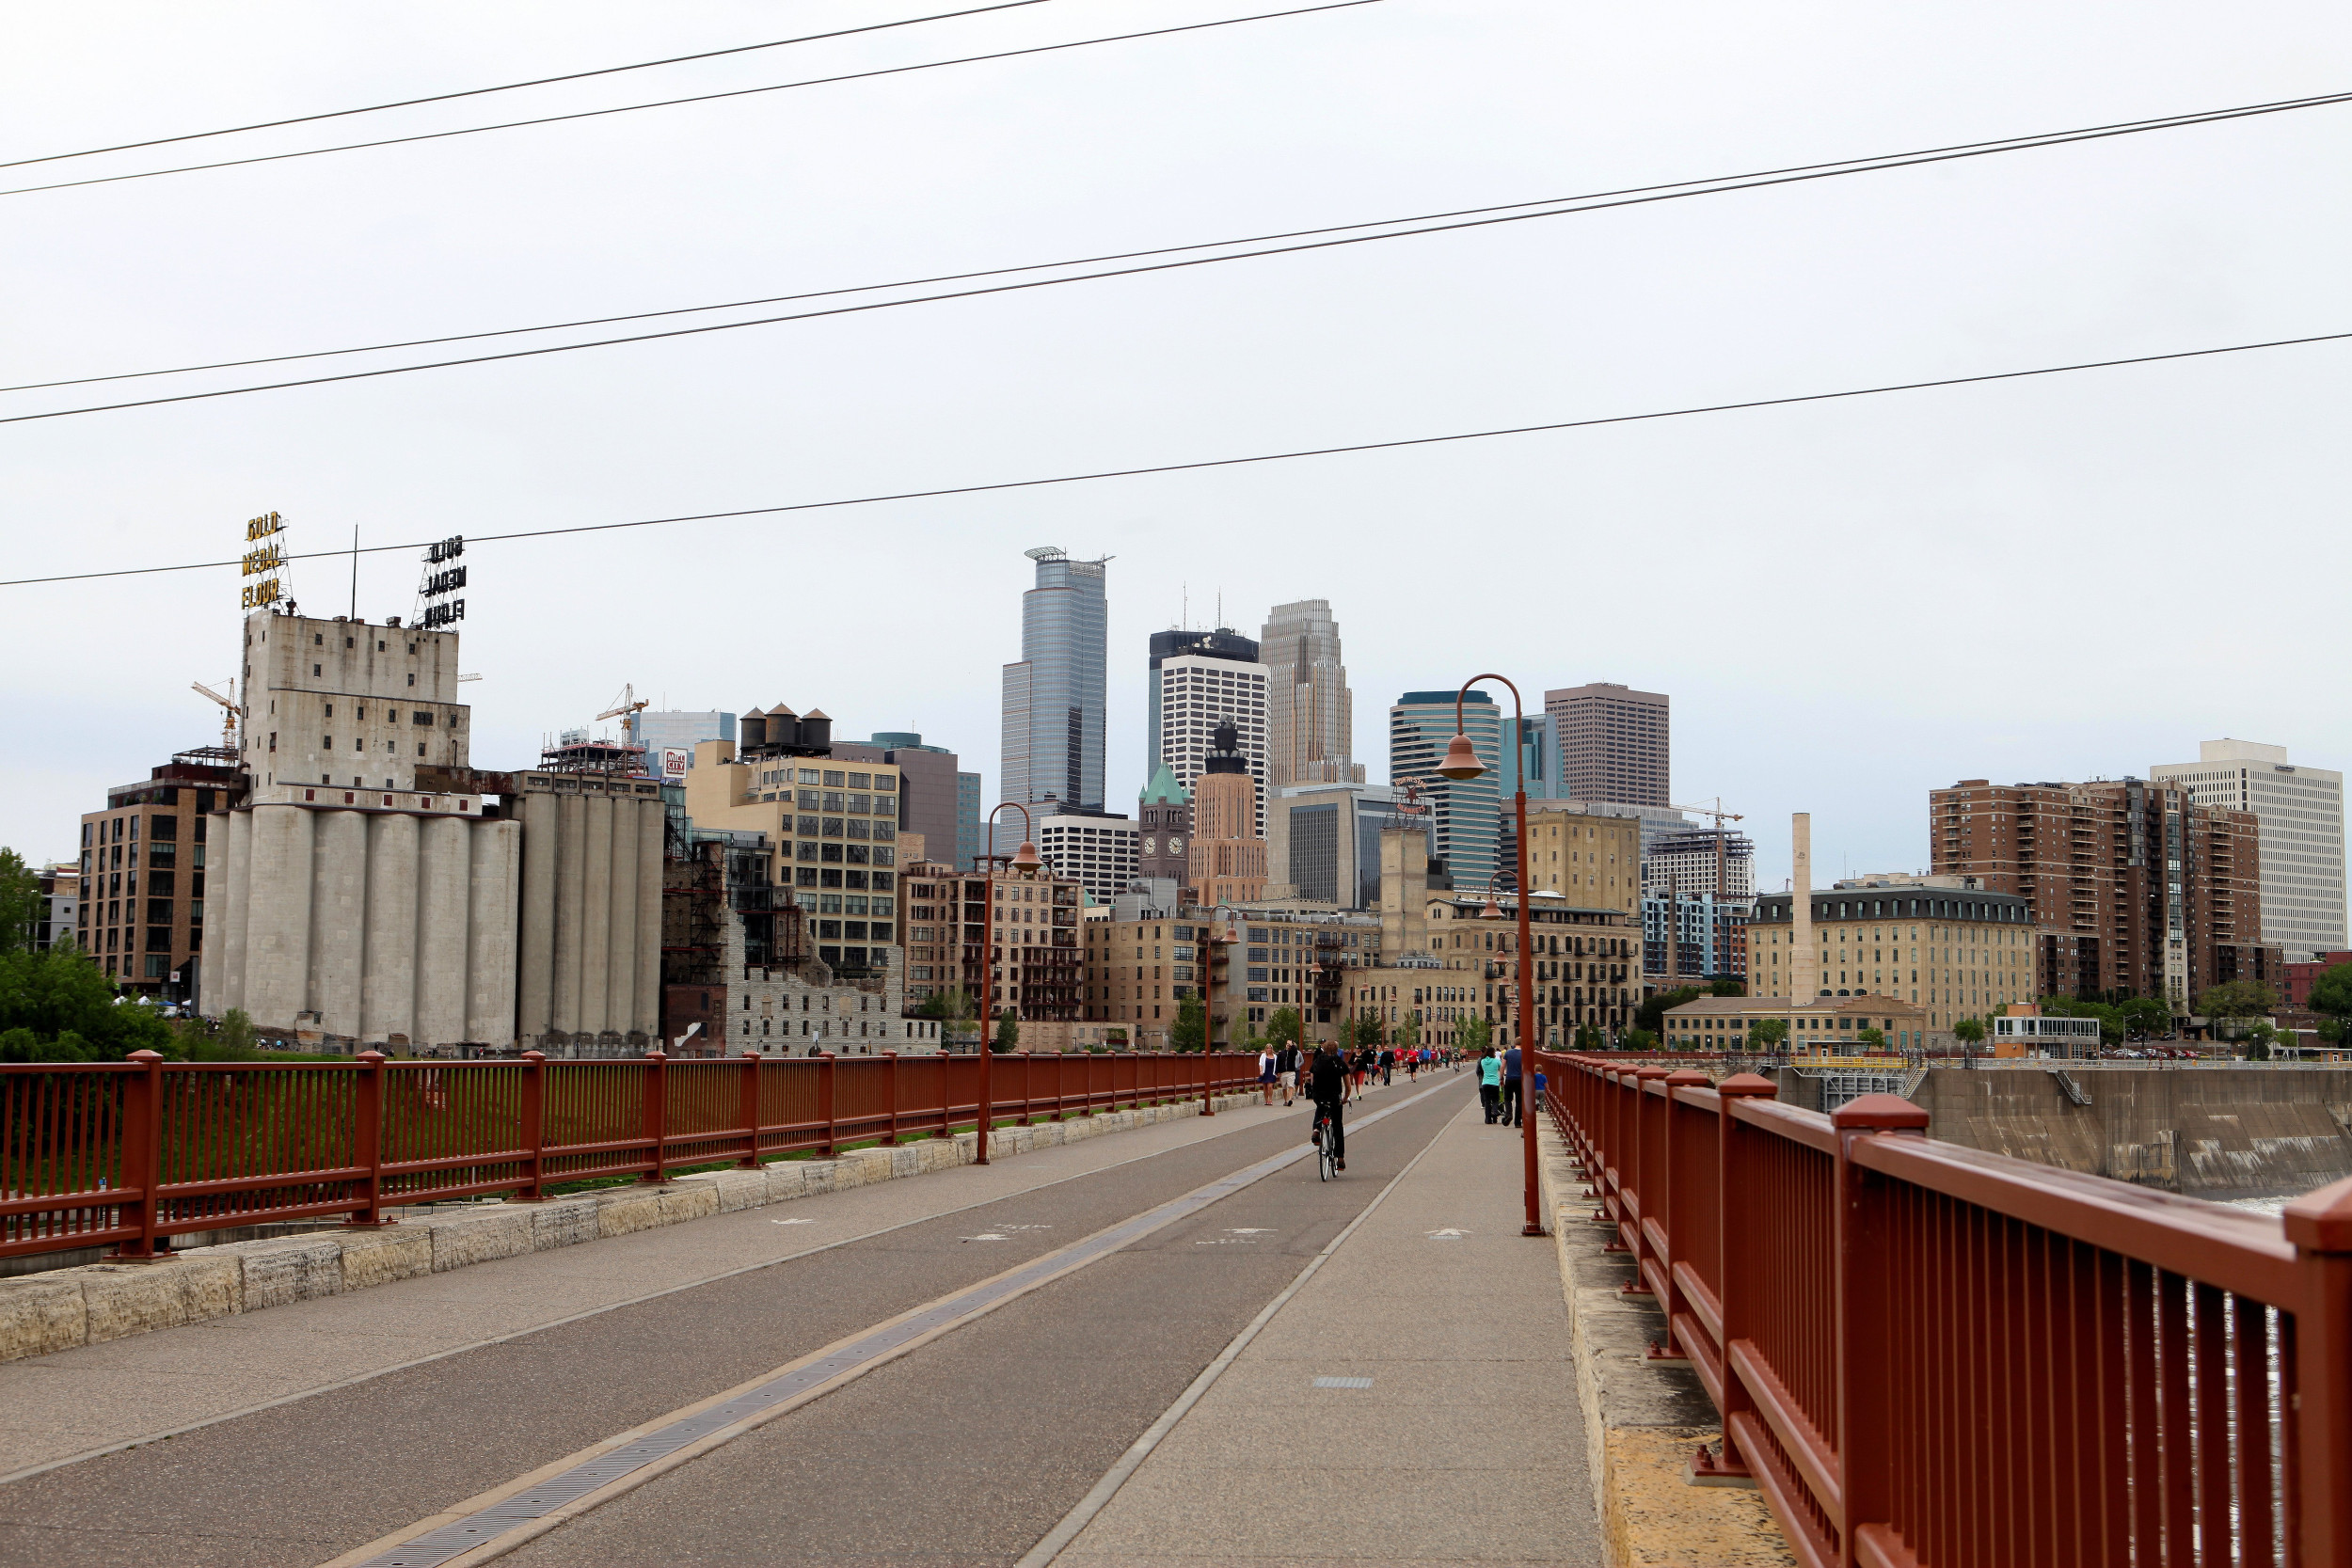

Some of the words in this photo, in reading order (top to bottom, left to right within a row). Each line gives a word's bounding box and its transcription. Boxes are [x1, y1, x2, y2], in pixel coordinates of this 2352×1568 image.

[246, 511, 278, 542] GOLD
[242, 543, 280, 577] MEDAL
[241, 578, 279, 610] FLOUR
[667, 753, 685, 762] MILL
[667, 761, 684, 769] CITY
